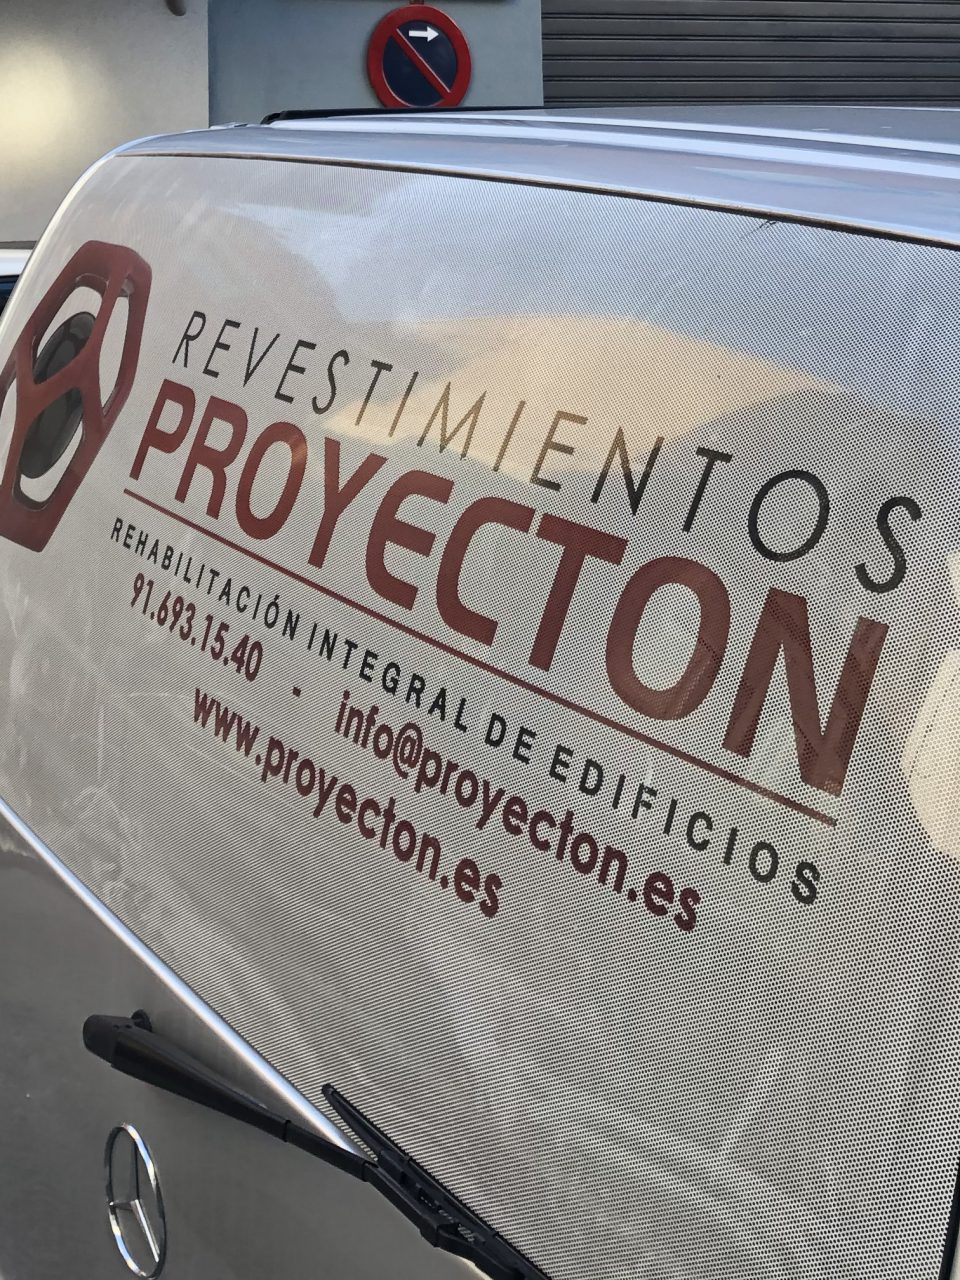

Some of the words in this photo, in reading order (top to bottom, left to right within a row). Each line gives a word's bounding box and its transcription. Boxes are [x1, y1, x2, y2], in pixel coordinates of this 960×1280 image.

[128, 378, 889, 798] PROYECTON
[173, 310, 922, 594] REVESTIMIENTOS
[110, 517, 300, 641] REHABILITACIÓN
[306, 623, 468, 713] INTEGRAL
[484, 712, 537, 765] DE
[549, 743, 821, 905] EDIFICIOS
[130, 572, 264, 682] 91.693.15.40
[334, 689, 701, 932] info@proyecton.es
[193, 687, 503, 918] www.proyecton.es
